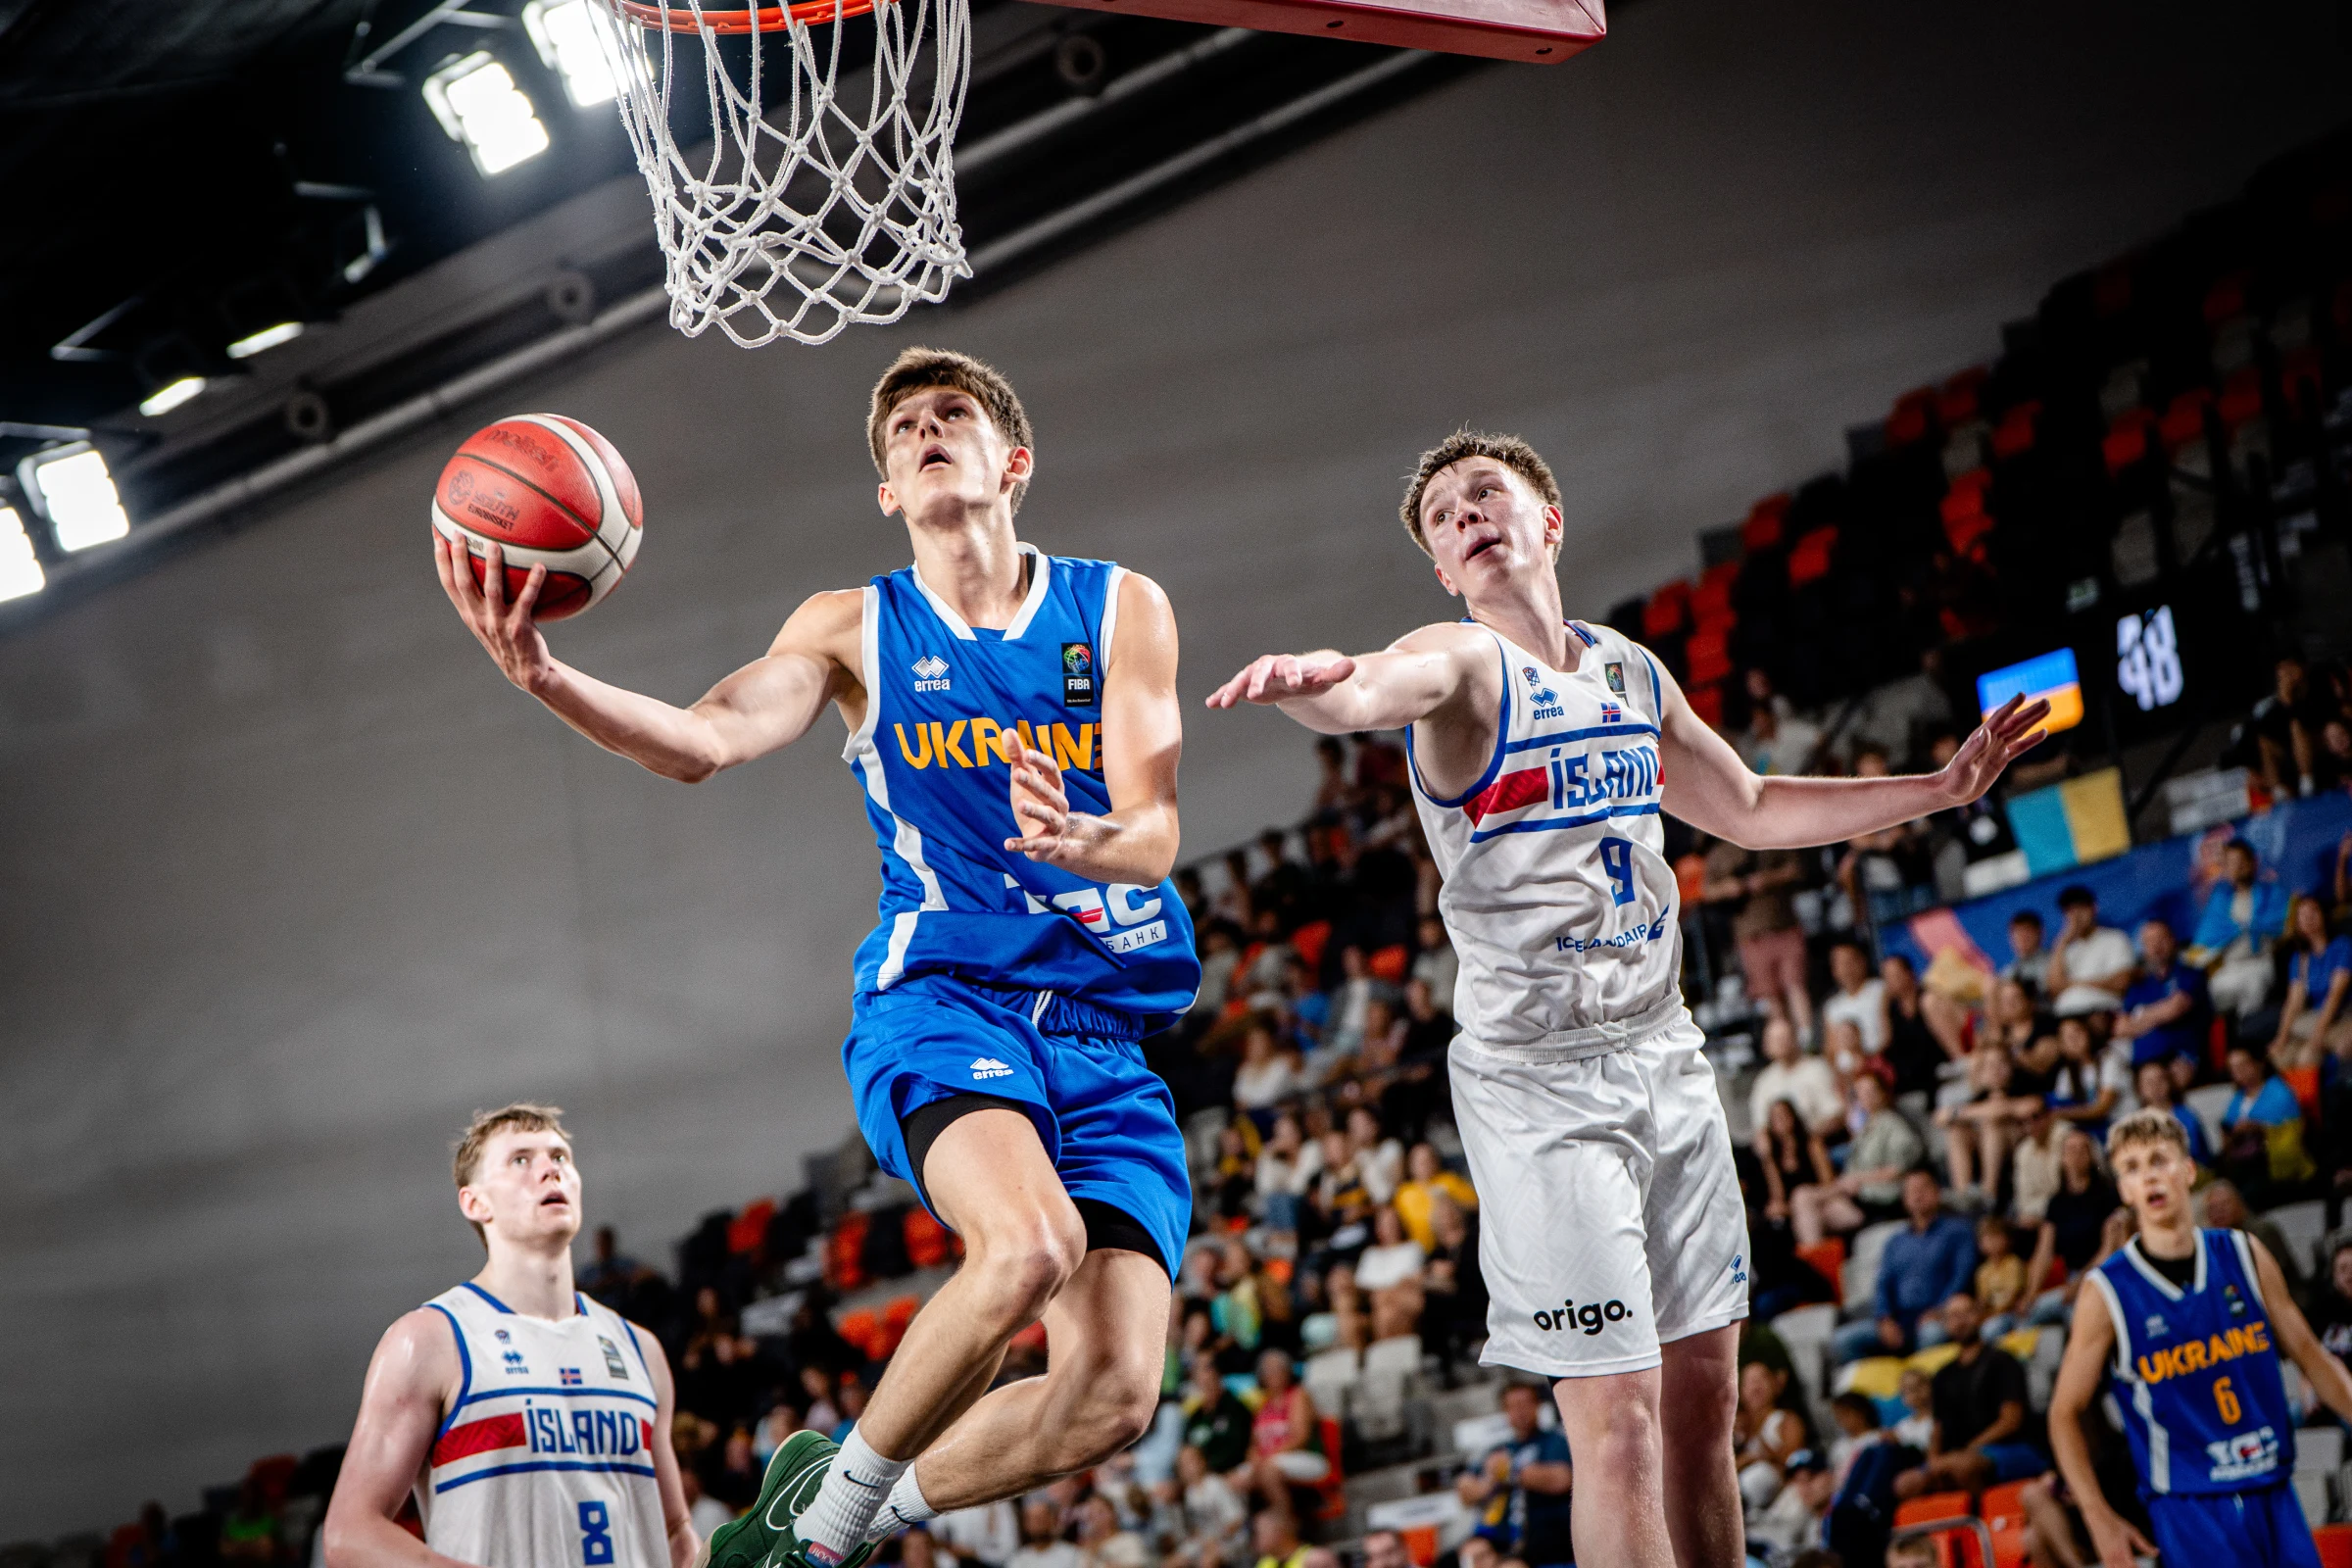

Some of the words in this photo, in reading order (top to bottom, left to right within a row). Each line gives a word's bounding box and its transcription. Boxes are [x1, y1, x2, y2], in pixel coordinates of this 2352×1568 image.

[914, 679, 951, 692] errea
[1068, 678, 1090, 690] FIBA
[1534, 706, 1564, 720] errea
[1599, 836, 1636, 908] 9
[972, 1069, 1014, 1080] errea
[2137, 1320, 2271, 1384] UKRAINE
[2213, 1376, 2242, 1425] 6
[577, 1500, 613, 1566] 8
